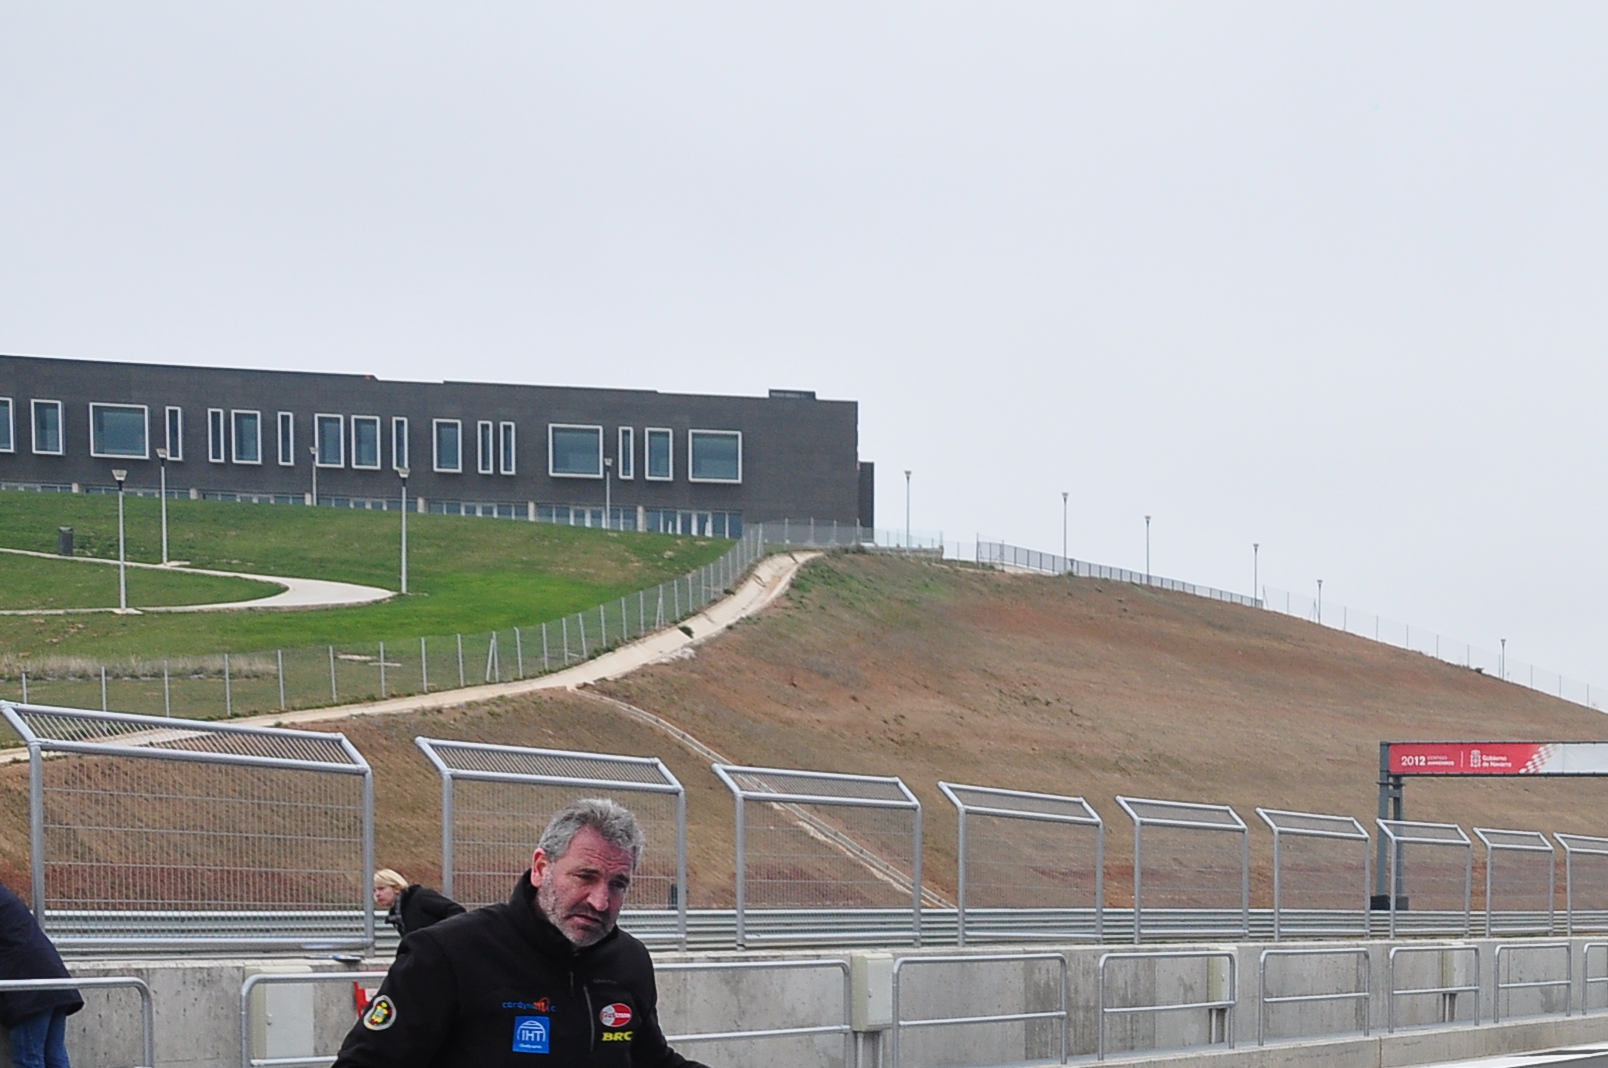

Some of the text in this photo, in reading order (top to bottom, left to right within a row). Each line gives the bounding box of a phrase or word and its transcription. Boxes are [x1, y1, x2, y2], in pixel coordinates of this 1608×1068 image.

[1401, 755, 1426, 767] 2012
[521, 1029, 544, 1042] IHT
[602, 1031, 633, 1042] BRC
